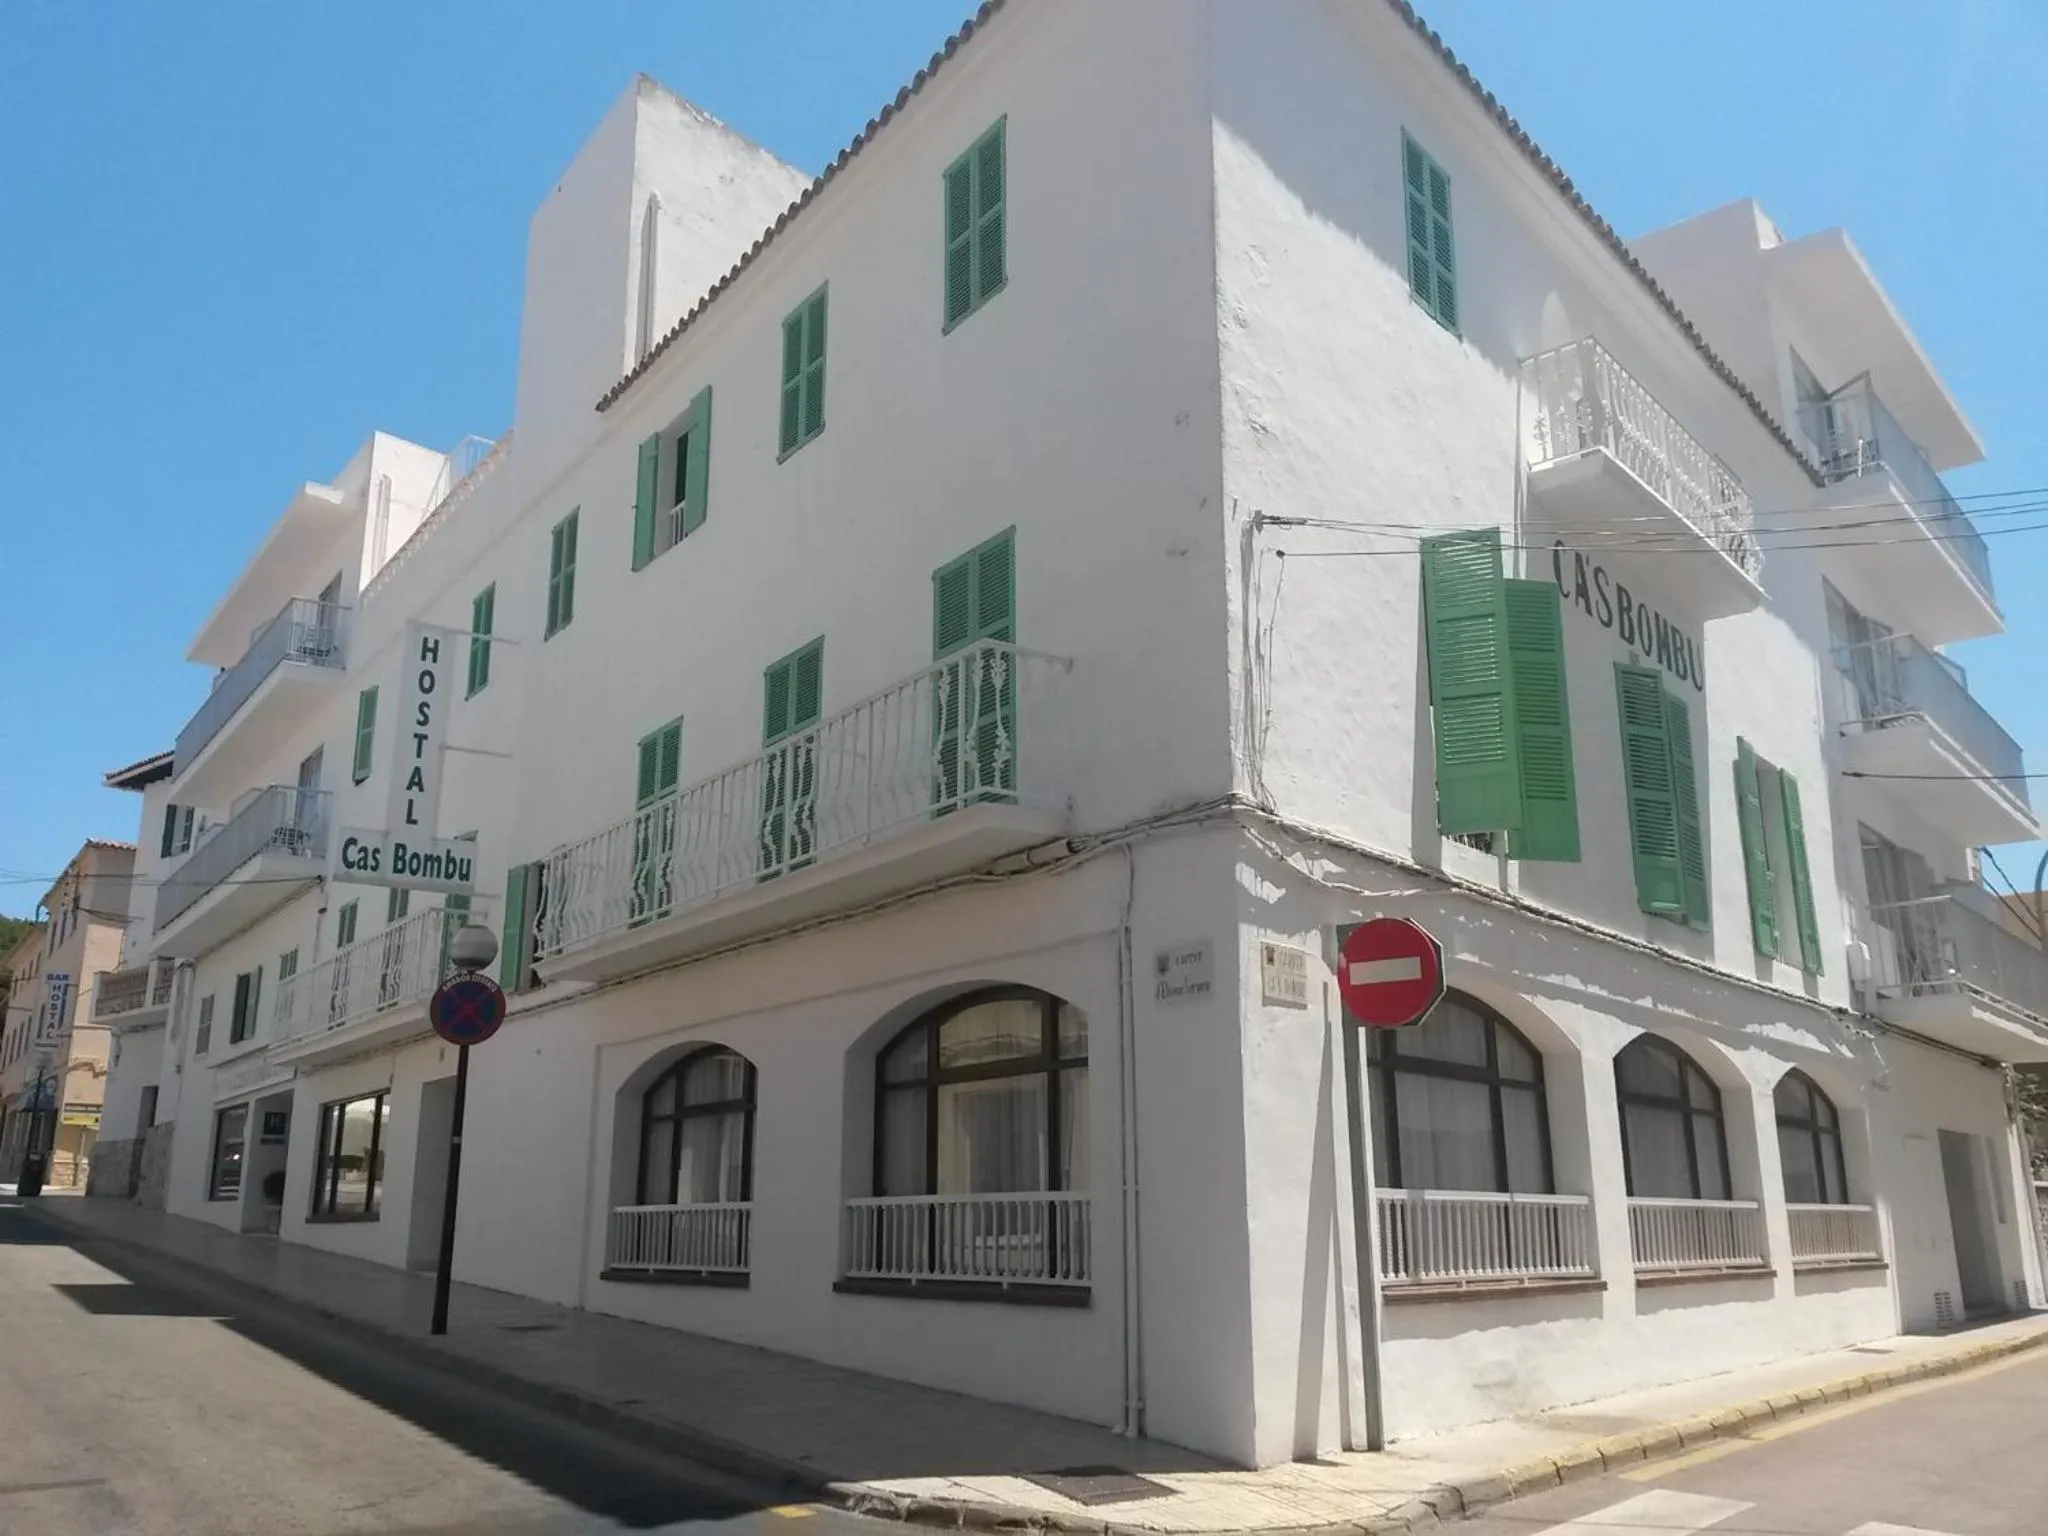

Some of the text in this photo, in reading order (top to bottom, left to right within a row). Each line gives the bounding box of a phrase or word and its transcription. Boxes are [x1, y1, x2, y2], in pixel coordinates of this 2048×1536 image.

[1616, 582, 1704, 692] BOMBU
[405, 636, 439, 825] HOSTAL
[342, 836, 472, 882] Cas Bombu
[46, 983, 62, 1039] HOSTAL
